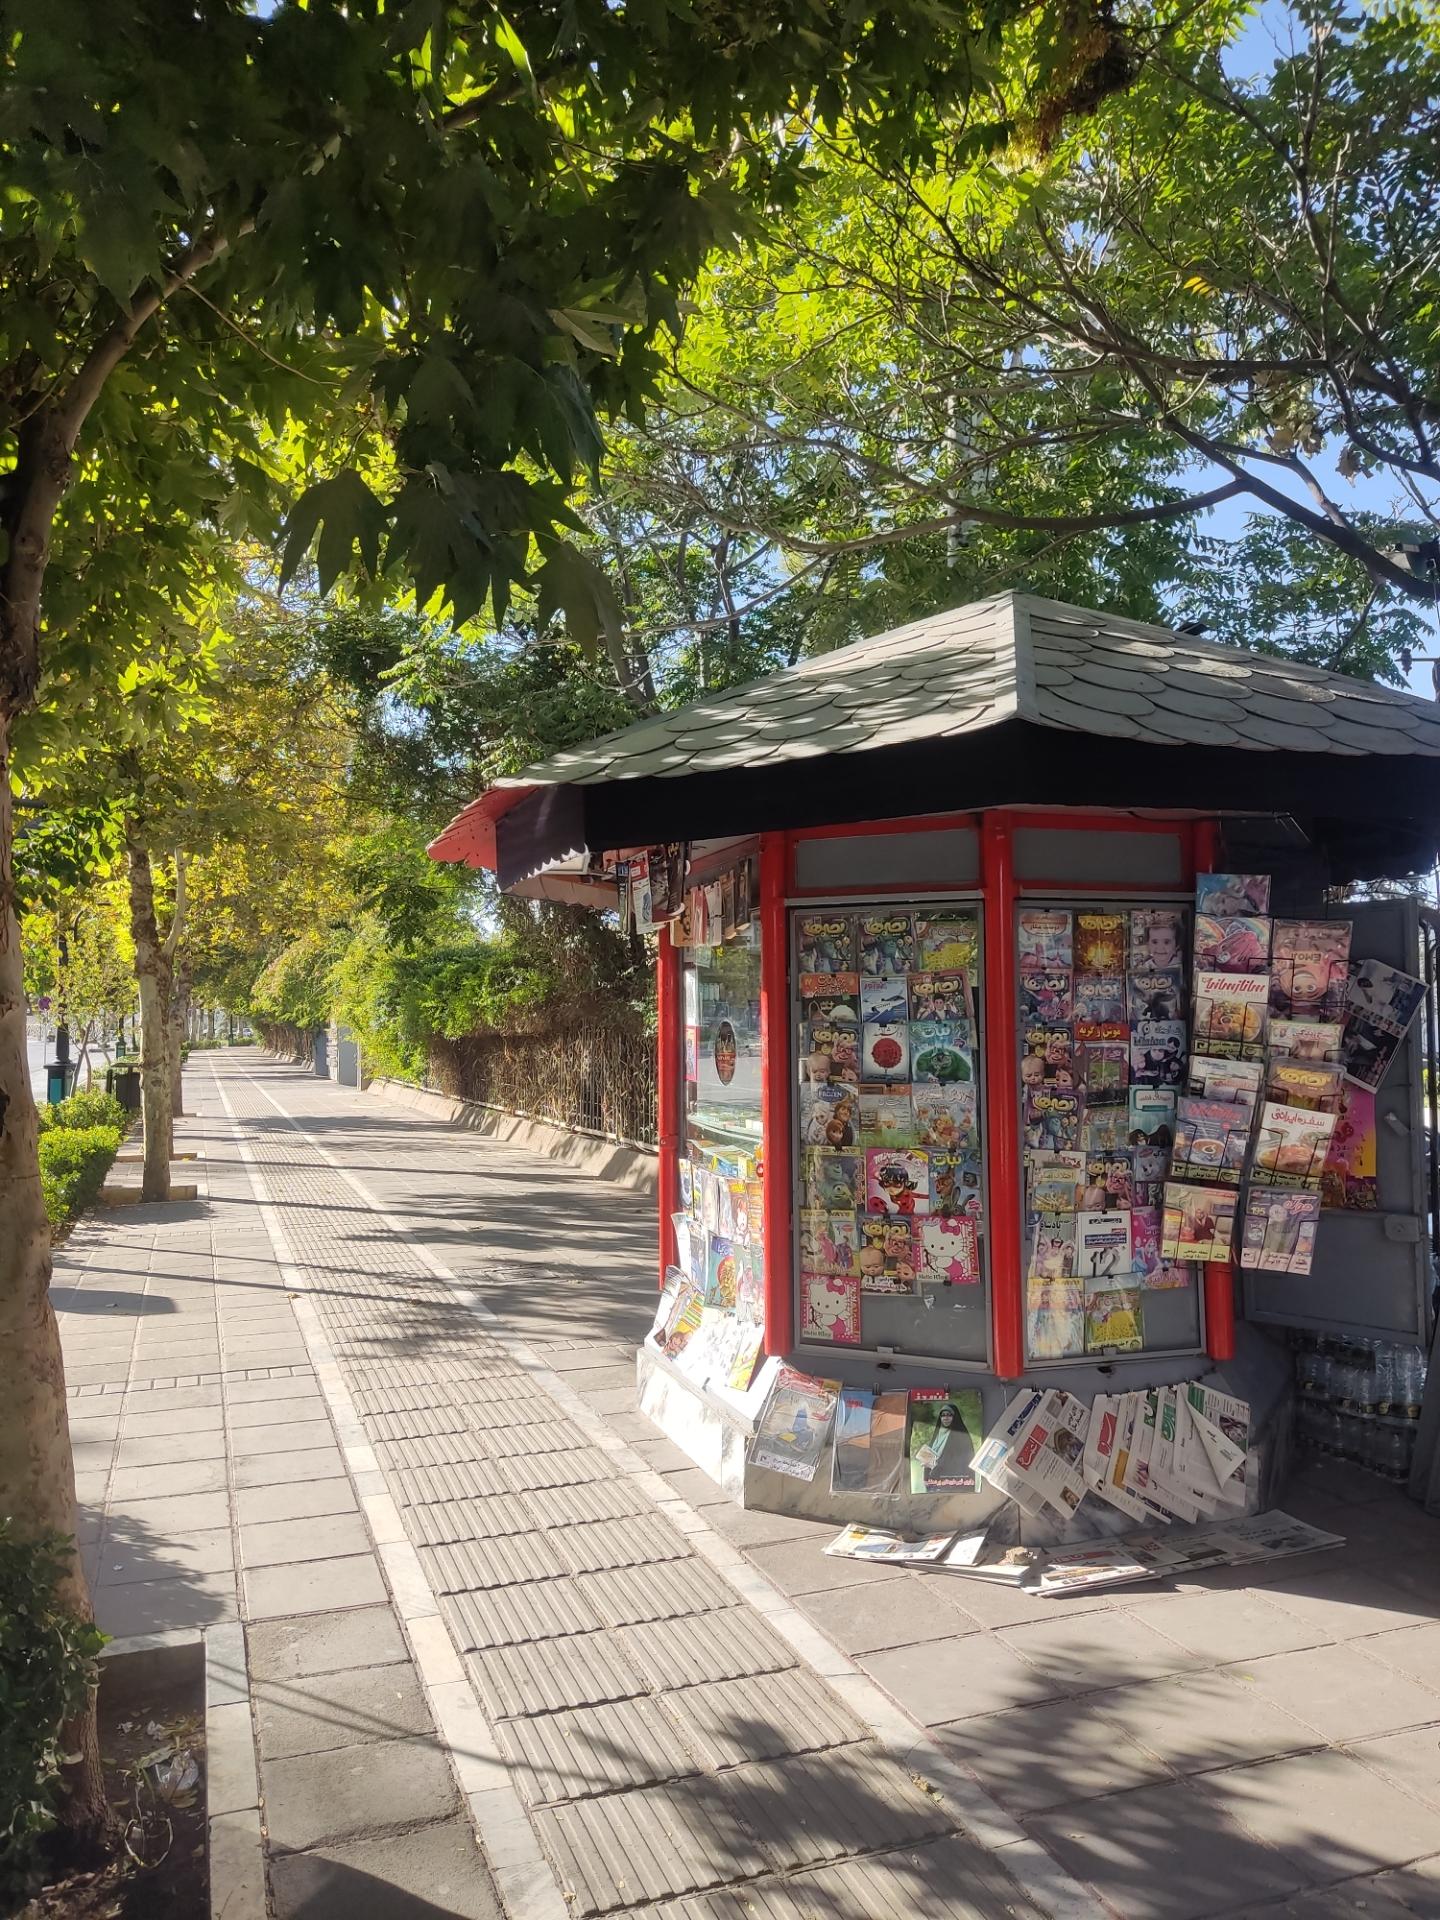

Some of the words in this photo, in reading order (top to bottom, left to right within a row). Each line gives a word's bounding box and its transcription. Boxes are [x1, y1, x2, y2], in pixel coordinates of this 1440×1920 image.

[1079, 1025, 1095, 1038] گربه
[1096, 1028, 1101, 1038] و
[1103, 1026, 1121, 1038] موش
